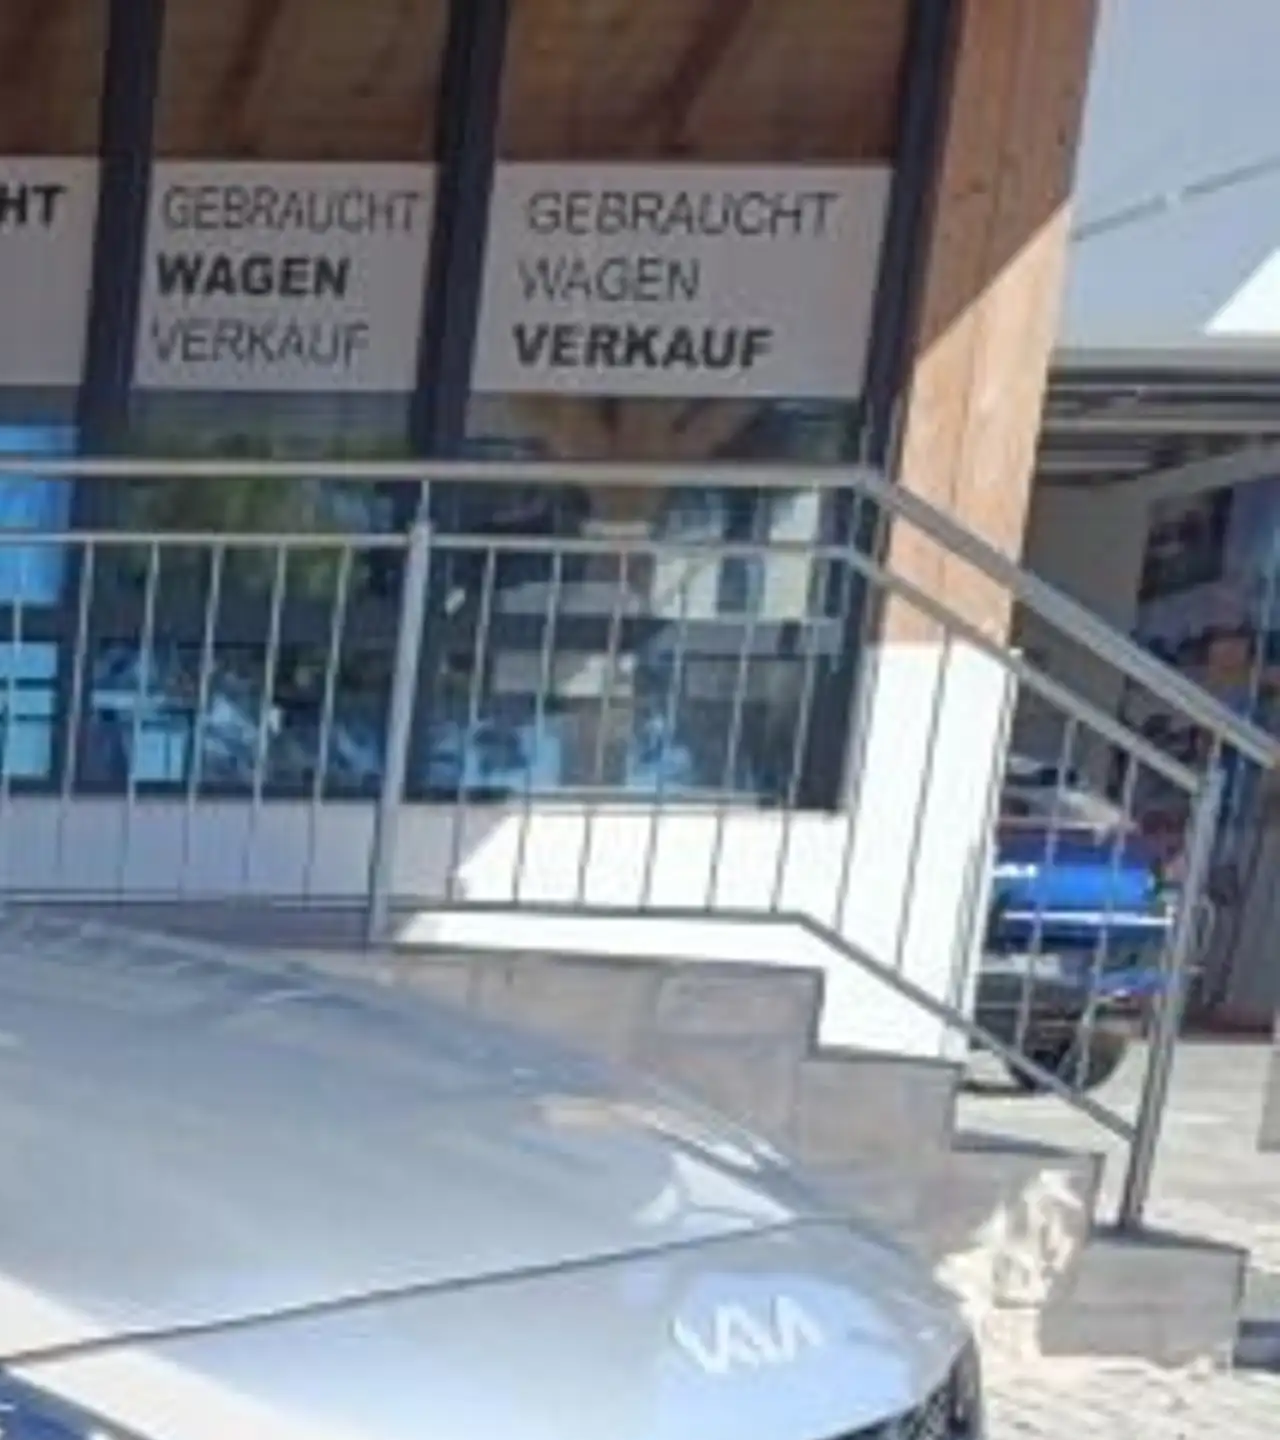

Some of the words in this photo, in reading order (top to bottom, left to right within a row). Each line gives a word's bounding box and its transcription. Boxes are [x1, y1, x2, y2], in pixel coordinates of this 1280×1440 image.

[160, 183, 420, 234] GEBRAUCHT
[526, 189, 839, 239] GEBRAUCHT
[155, 252, 351, 299] WAGEN
[516, 255, 702, 302] WAGEN
[150, 315, 371, 368] VERKAUF
[511, 323, 775, 370] VERKAUF
